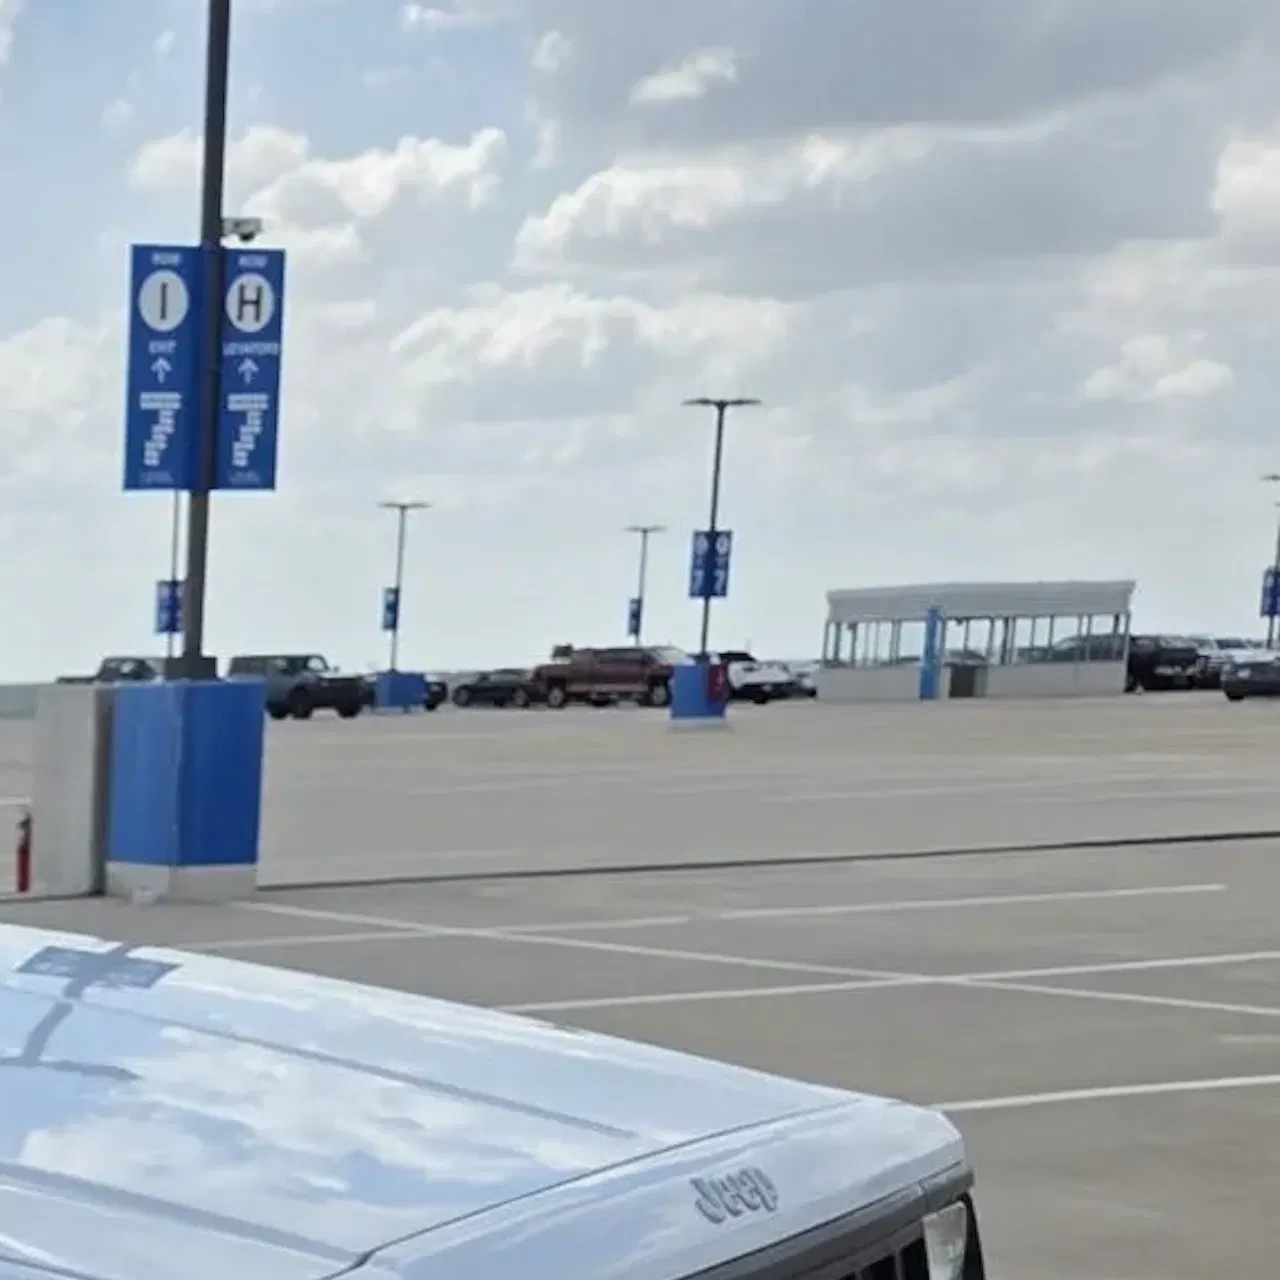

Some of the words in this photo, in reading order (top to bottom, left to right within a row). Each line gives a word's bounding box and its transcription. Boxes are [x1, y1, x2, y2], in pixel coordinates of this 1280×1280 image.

[160, 281, 168, 321] I
[237, 283, 264, 323] H
[690, 1166, 778, 1224] Jeep
